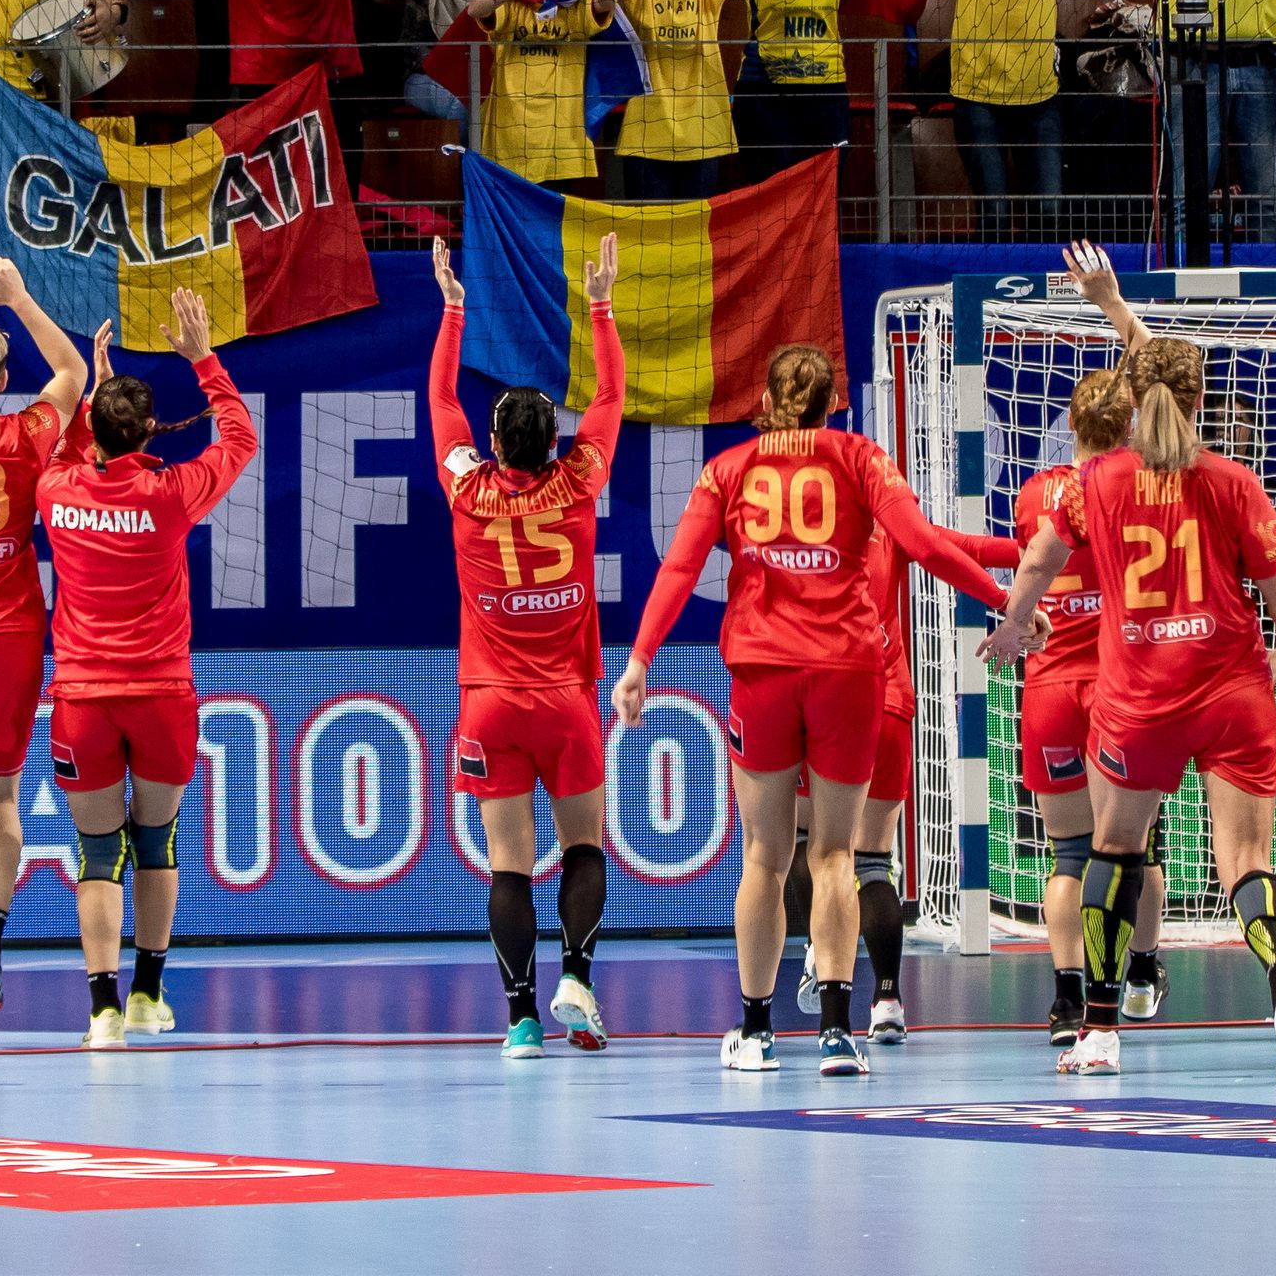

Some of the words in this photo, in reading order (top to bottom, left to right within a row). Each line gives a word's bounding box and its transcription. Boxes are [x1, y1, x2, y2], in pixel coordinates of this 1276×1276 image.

[784, 14, 827, 39] NIRO
[51, 502, 157, 533] ROMANIA
[741, 465, 837, 546] 90
[482, 510, 576, 586] 15
[768, 548, 832, 570] PROFI
[1123, 519, 1204, 610] 21
[512, 588, 581, 612] PROFI
[1153, 618, 1208, 640] PROFI
